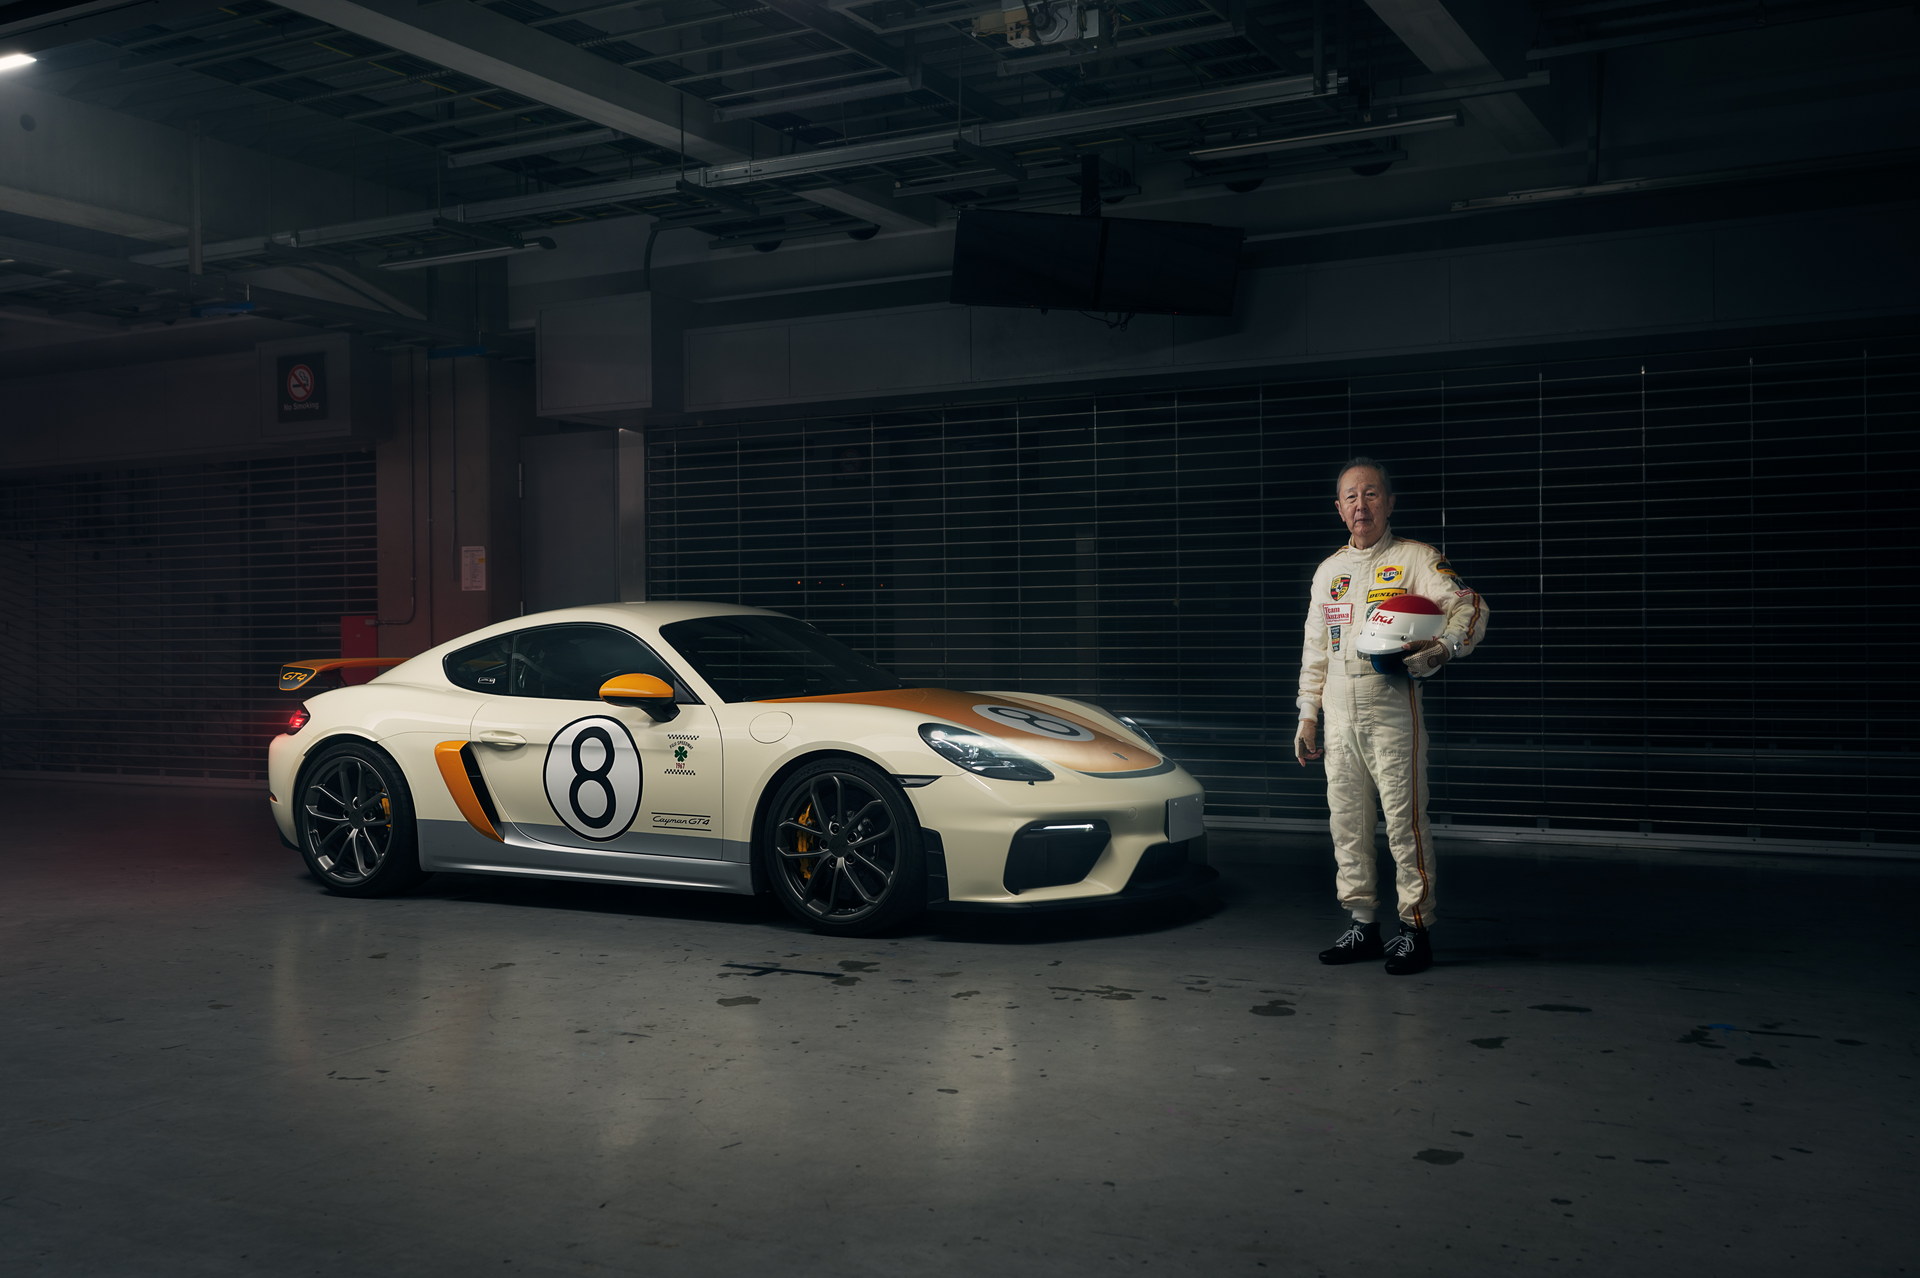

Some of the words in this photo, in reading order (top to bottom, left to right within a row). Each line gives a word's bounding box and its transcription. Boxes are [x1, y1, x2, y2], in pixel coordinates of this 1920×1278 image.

[283, 403, 292, 411] No
[293, 402, 320, 410] Smoking
[1377, 570, 1402, 578] PEPSI
[1368, 611, 1395, 625] Arai
[282, 672, 308, 682] GT4
[988, 706, 1081, 737] 8
[569, 726, 615, 829] 8
[652, 815, 687, 826] Cayman
[688, 818, 711, 826] GT4
